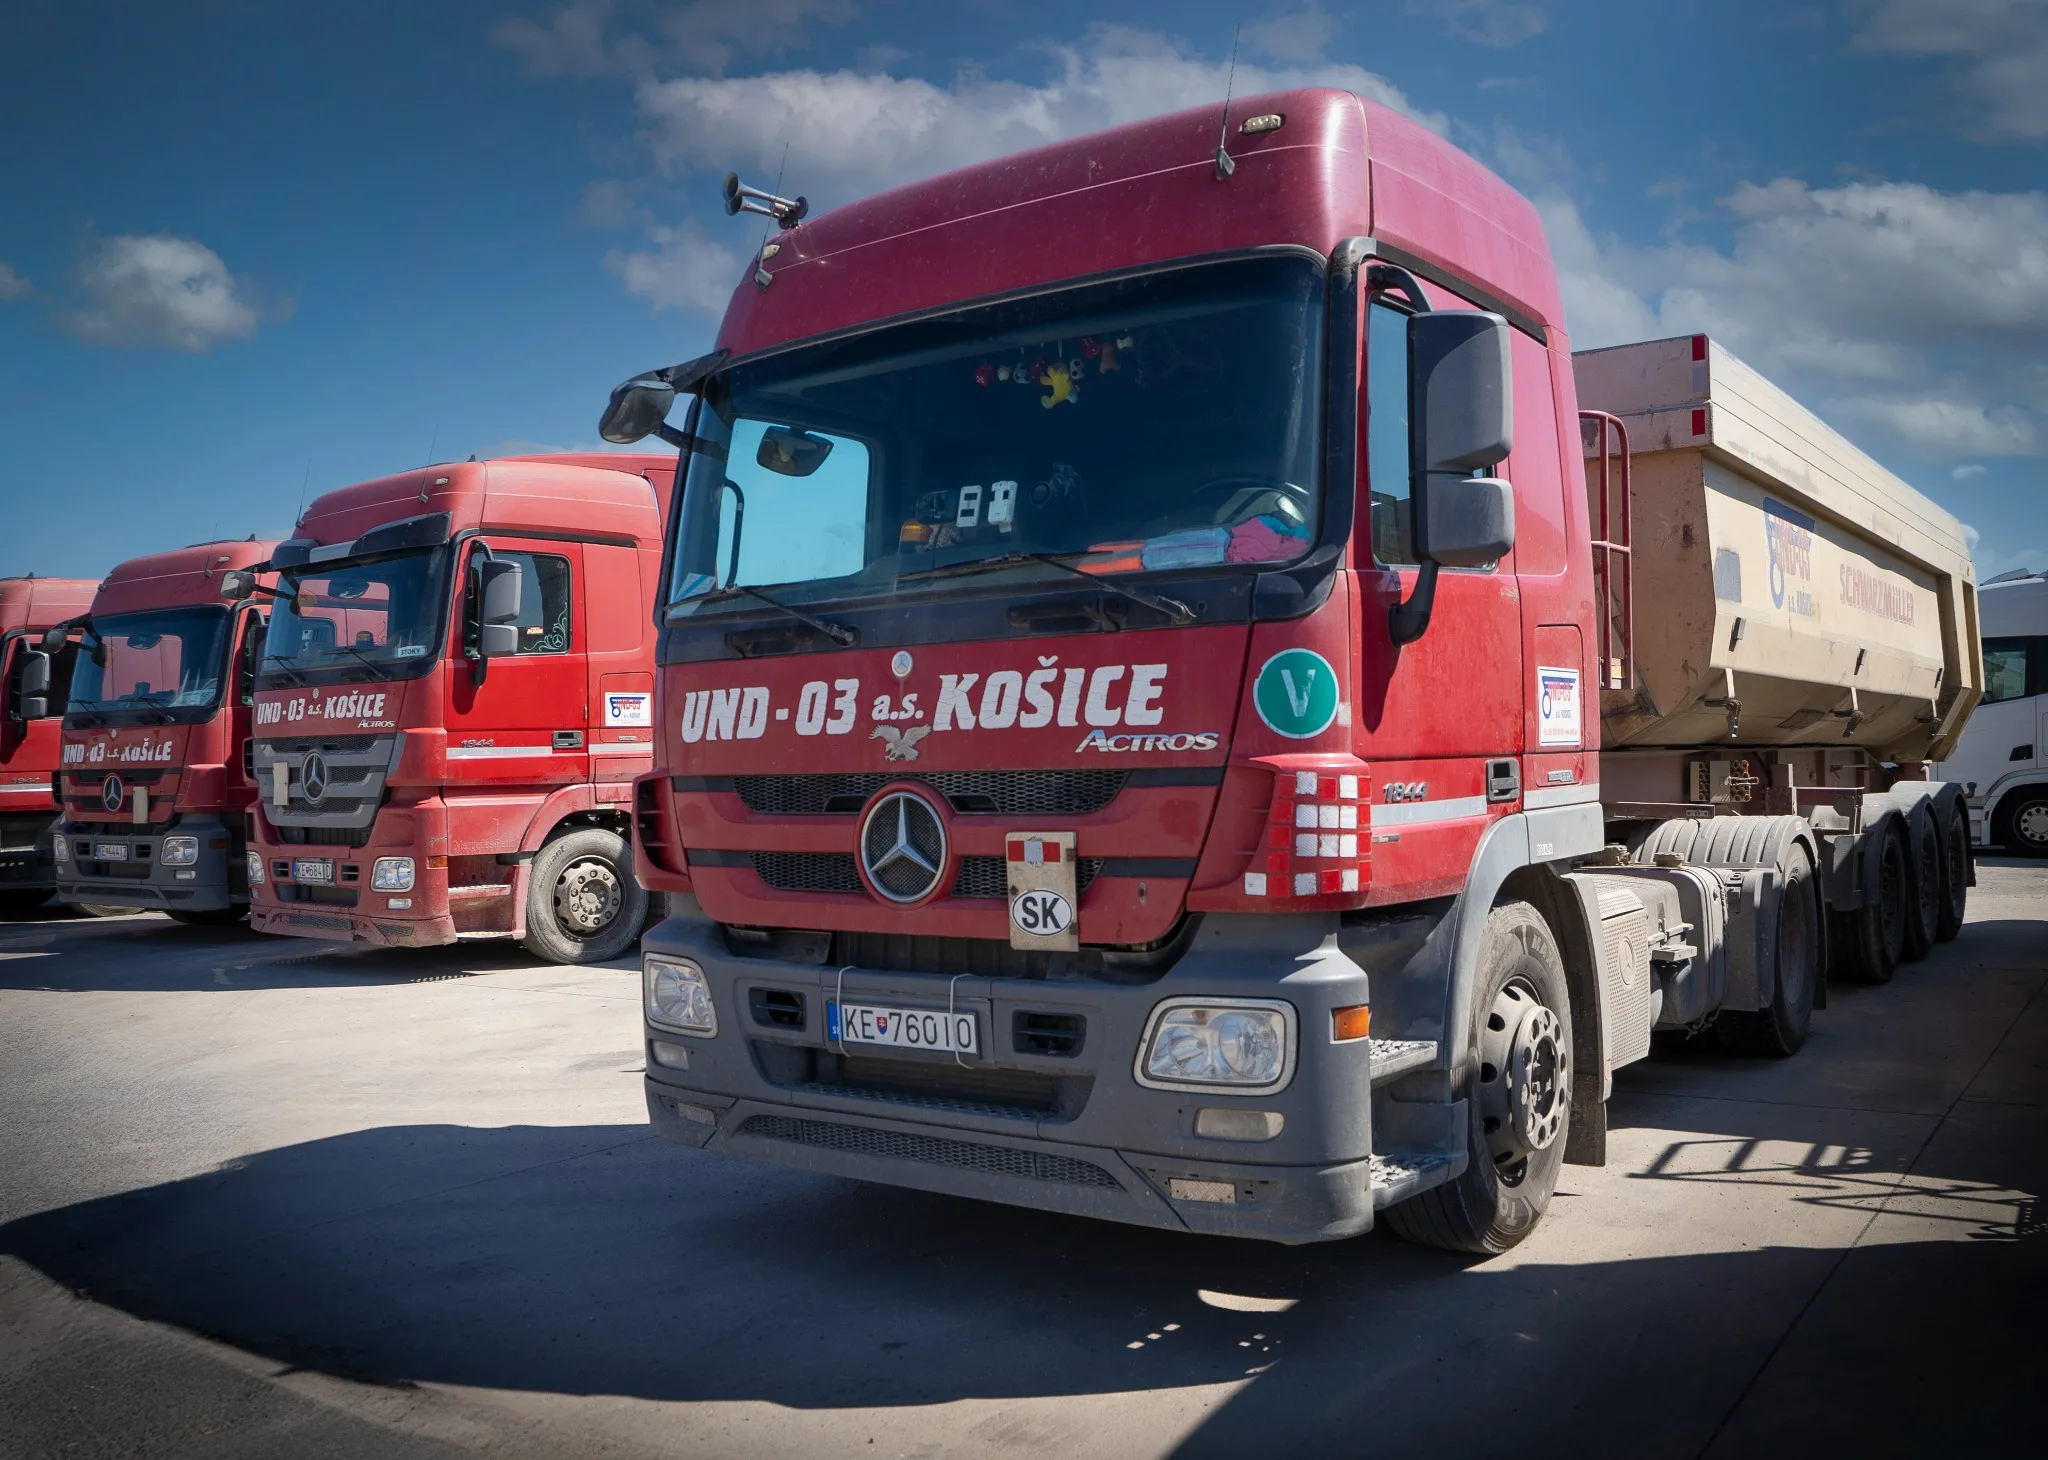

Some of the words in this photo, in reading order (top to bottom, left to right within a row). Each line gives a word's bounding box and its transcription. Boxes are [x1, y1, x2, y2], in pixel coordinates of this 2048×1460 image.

[1839, 564, 1914, 623] SCHWARZMÜLLER
[401, 648, 420, 656] STOKY
[307, 704, 322, 715] a.s.
[324, 690, 386, 719] KOŠICE
[871, 693, 924, 721] a.s.
[933, 655, 1168, 731] KOŠICE
[1280, 669, 1316, 717] V
[1383, 782, 1427, 804] 1844
[297, 863, 306, 876] KE
[1021, 897, 1061, 929] SK
[844, 1008, 875, 1040] KE
